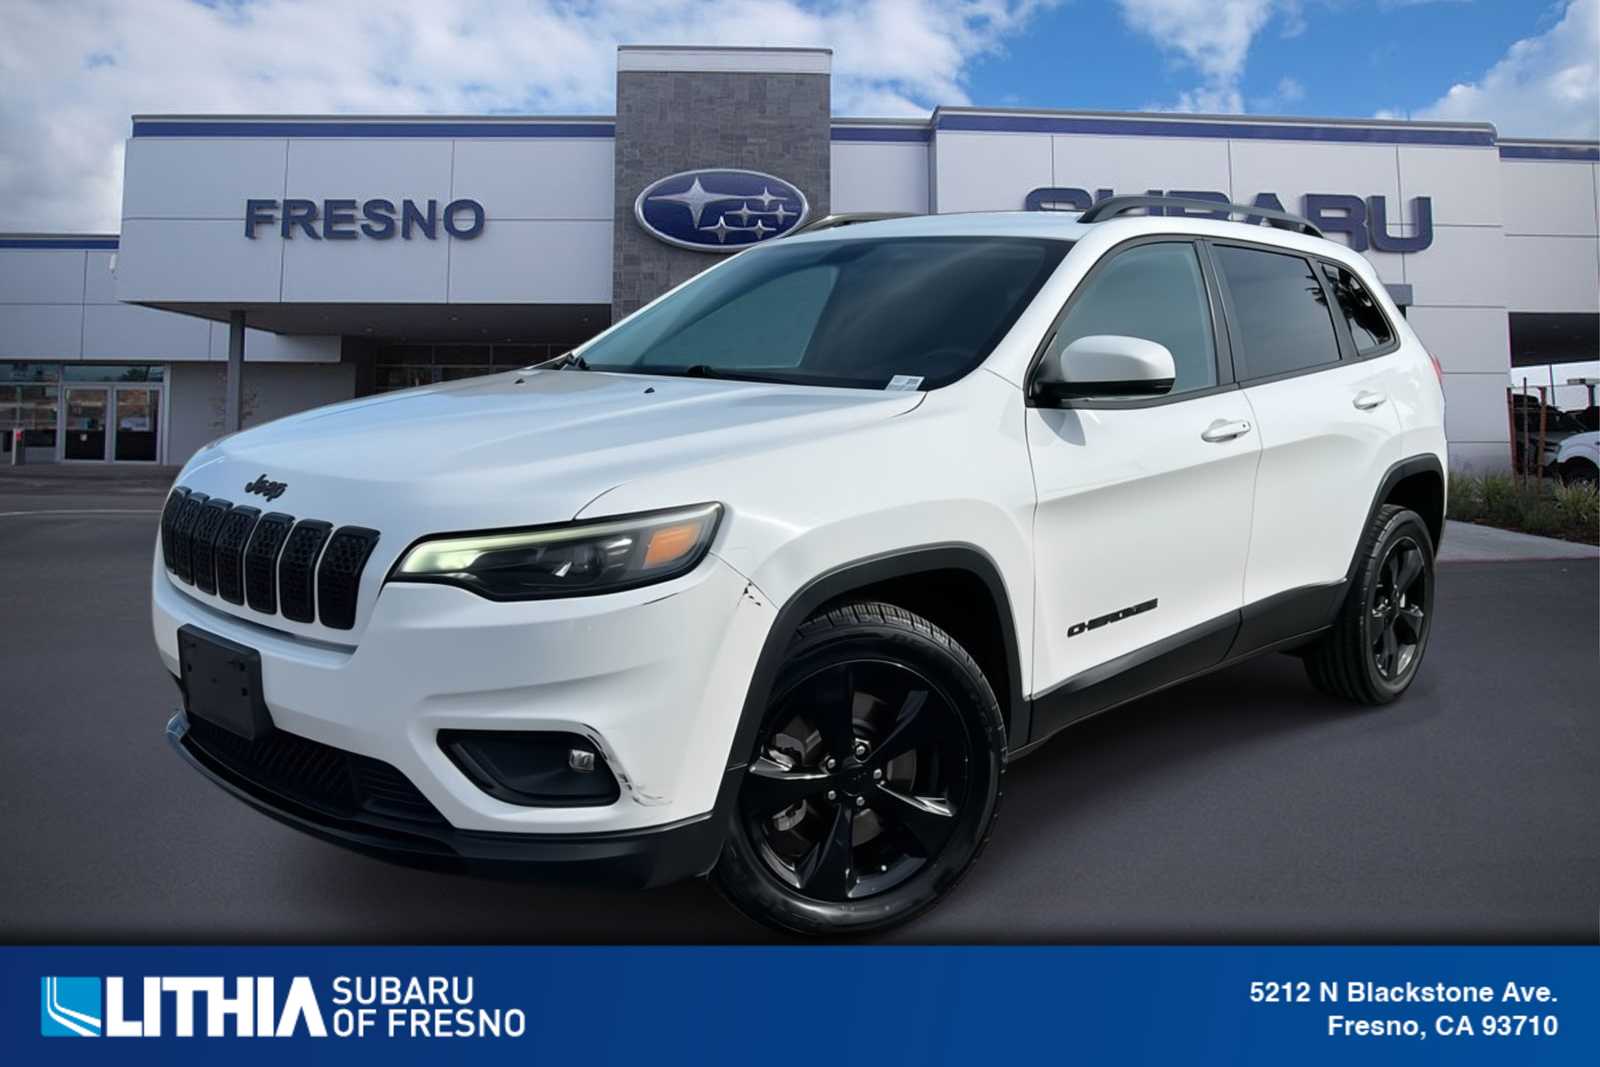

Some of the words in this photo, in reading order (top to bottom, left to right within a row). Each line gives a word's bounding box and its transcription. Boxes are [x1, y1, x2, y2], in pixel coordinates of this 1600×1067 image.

[244, 198, 486, 241] FRESNO
[1025, 187, 1433, 253] ARU
[245, 474, 288, 502] Jeep
